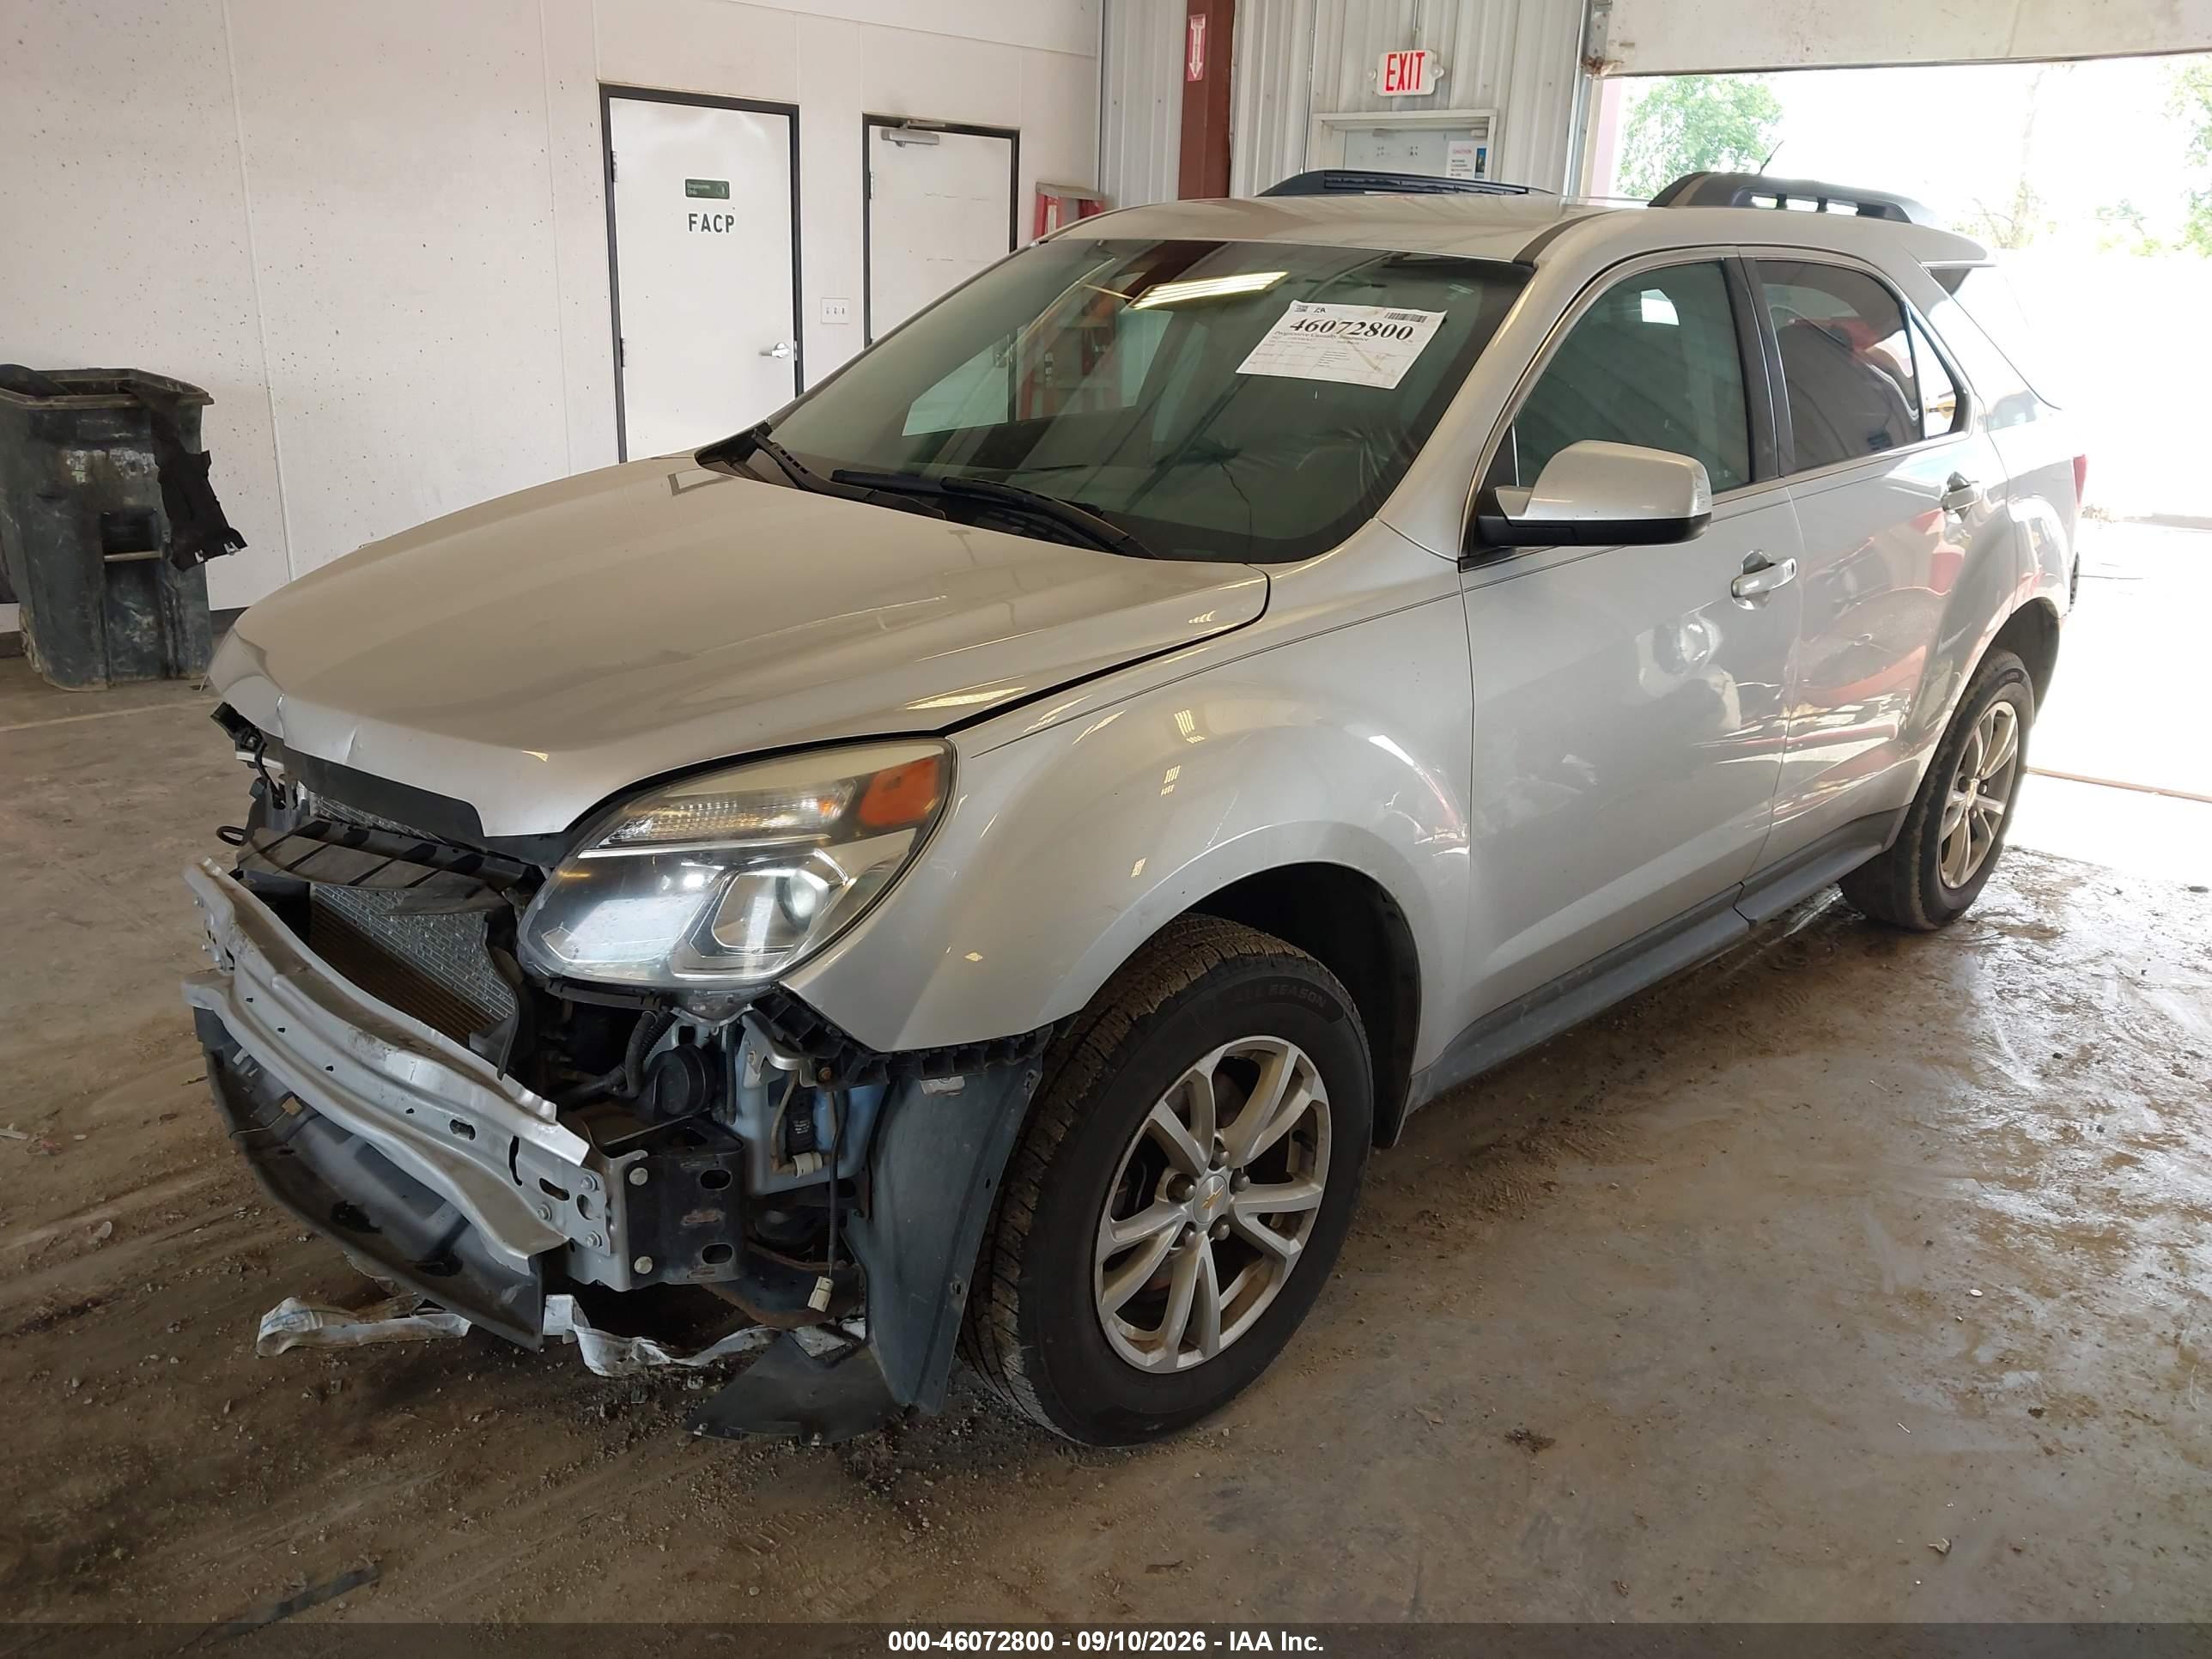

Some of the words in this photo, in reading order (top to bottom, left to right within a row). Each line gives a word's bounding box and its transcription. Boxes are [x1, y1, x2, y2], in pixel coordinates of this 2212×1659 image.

[1385, 52, 1426, 92] EXIT
[688, 213, 735, 234] FACP
[1289, 319, 1414, 341] 46072800
[1267, 984, 1327, 1008] SEASON
